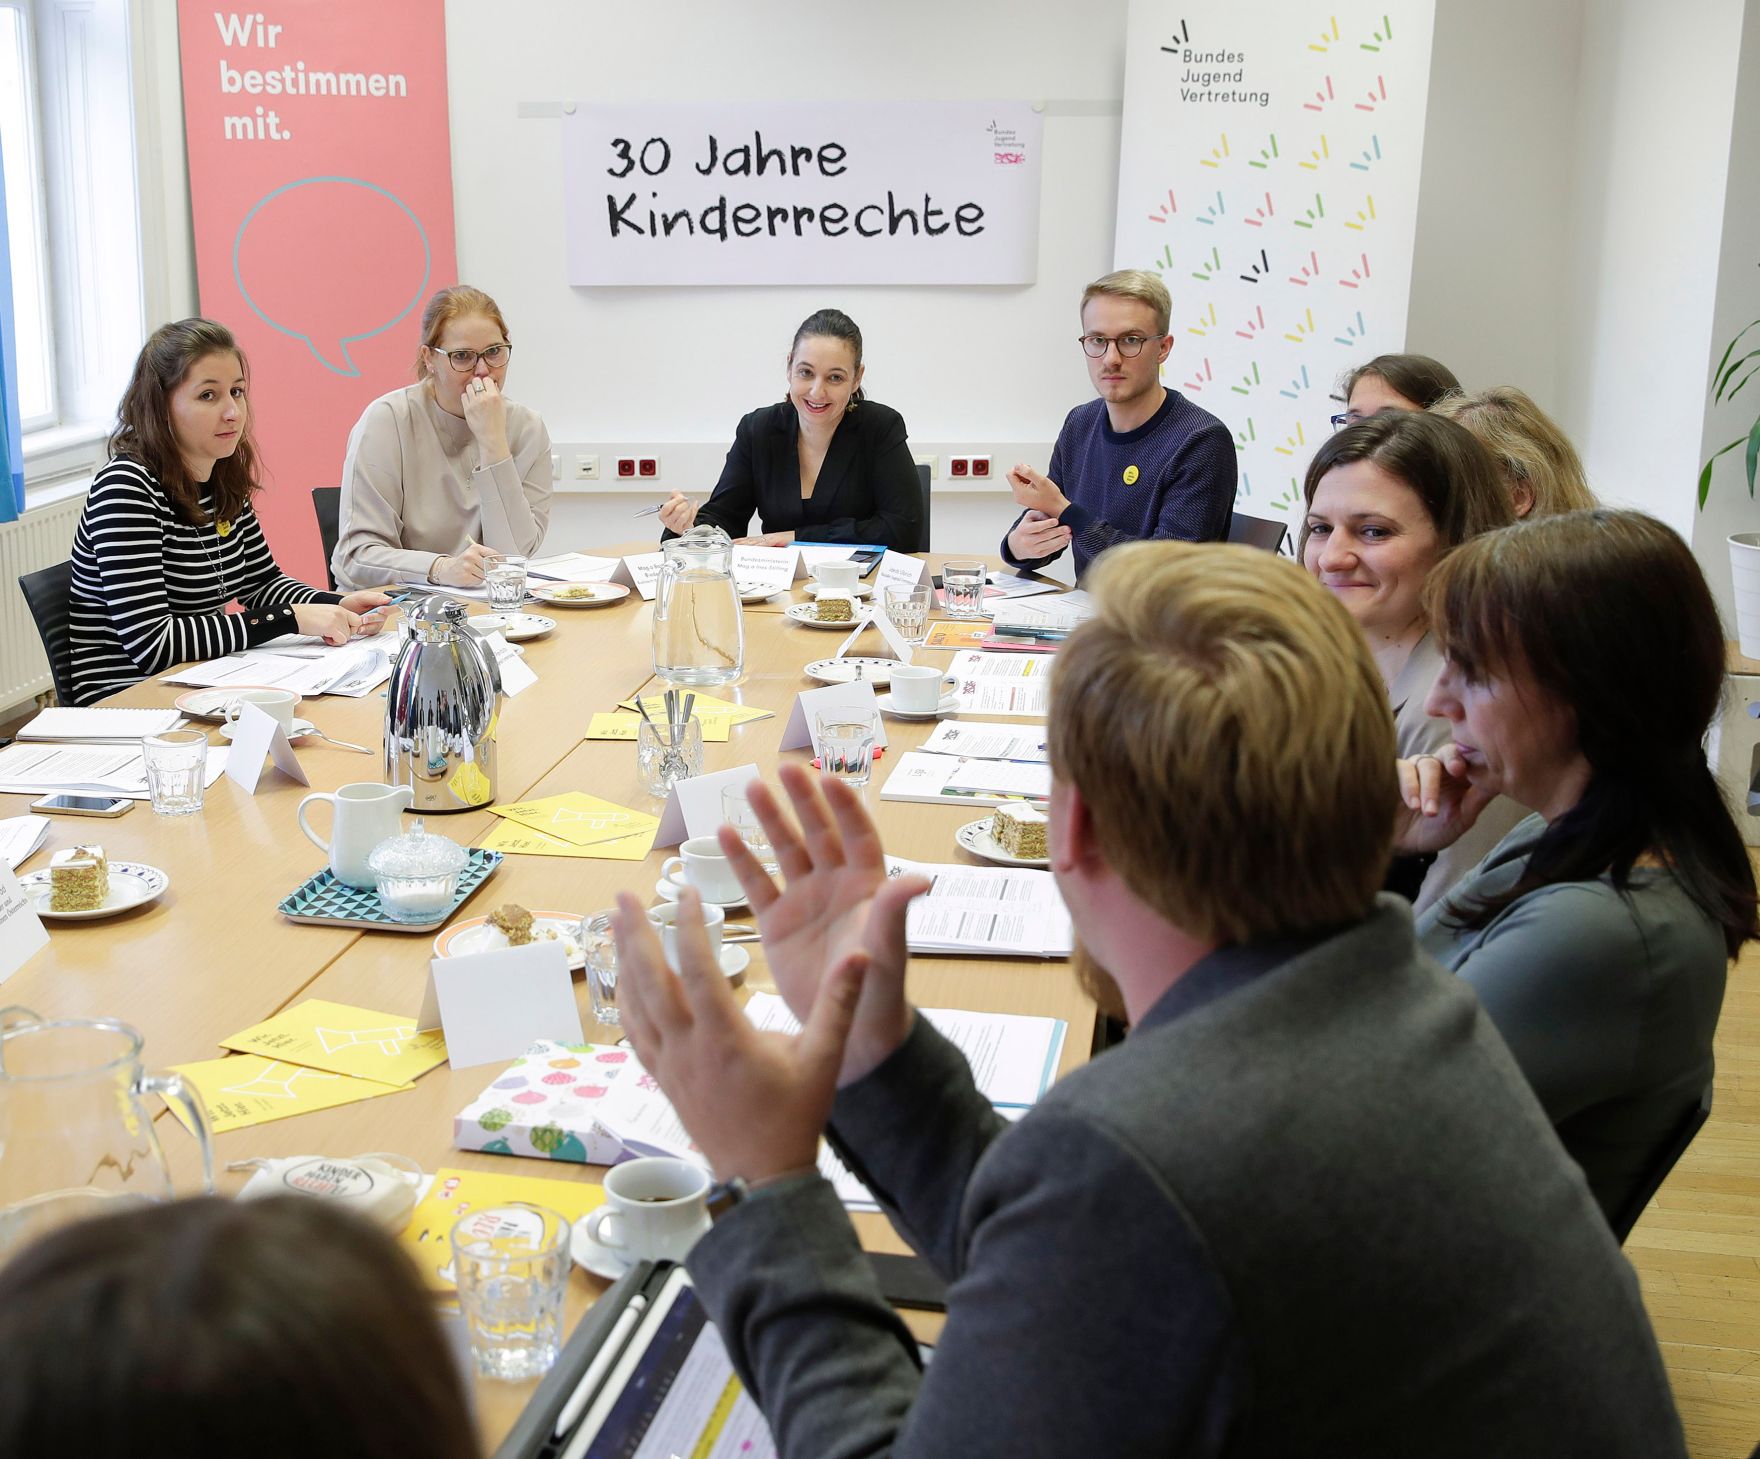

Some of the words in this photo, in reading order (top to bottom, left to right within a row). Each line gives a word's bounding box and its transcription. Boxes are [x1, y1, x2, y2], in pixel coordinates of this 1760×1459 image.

[214, 12, 283, 48] Wir
[1183, 49, 1244, 63] Bundes
[220, 60, 407, 98] bestimmen
[1180, 68, 1243, 87] Jugend
[1180, 88, 1269, 107] Vertretung
[224, 106, 291, 140] mit.
[606, 137, 671, 179] 30
[695, 130, 848, 177] Jahre
[606, 191, 986, 243] Kinderrechte
[318, 1162, 363, 1181] KINDER
